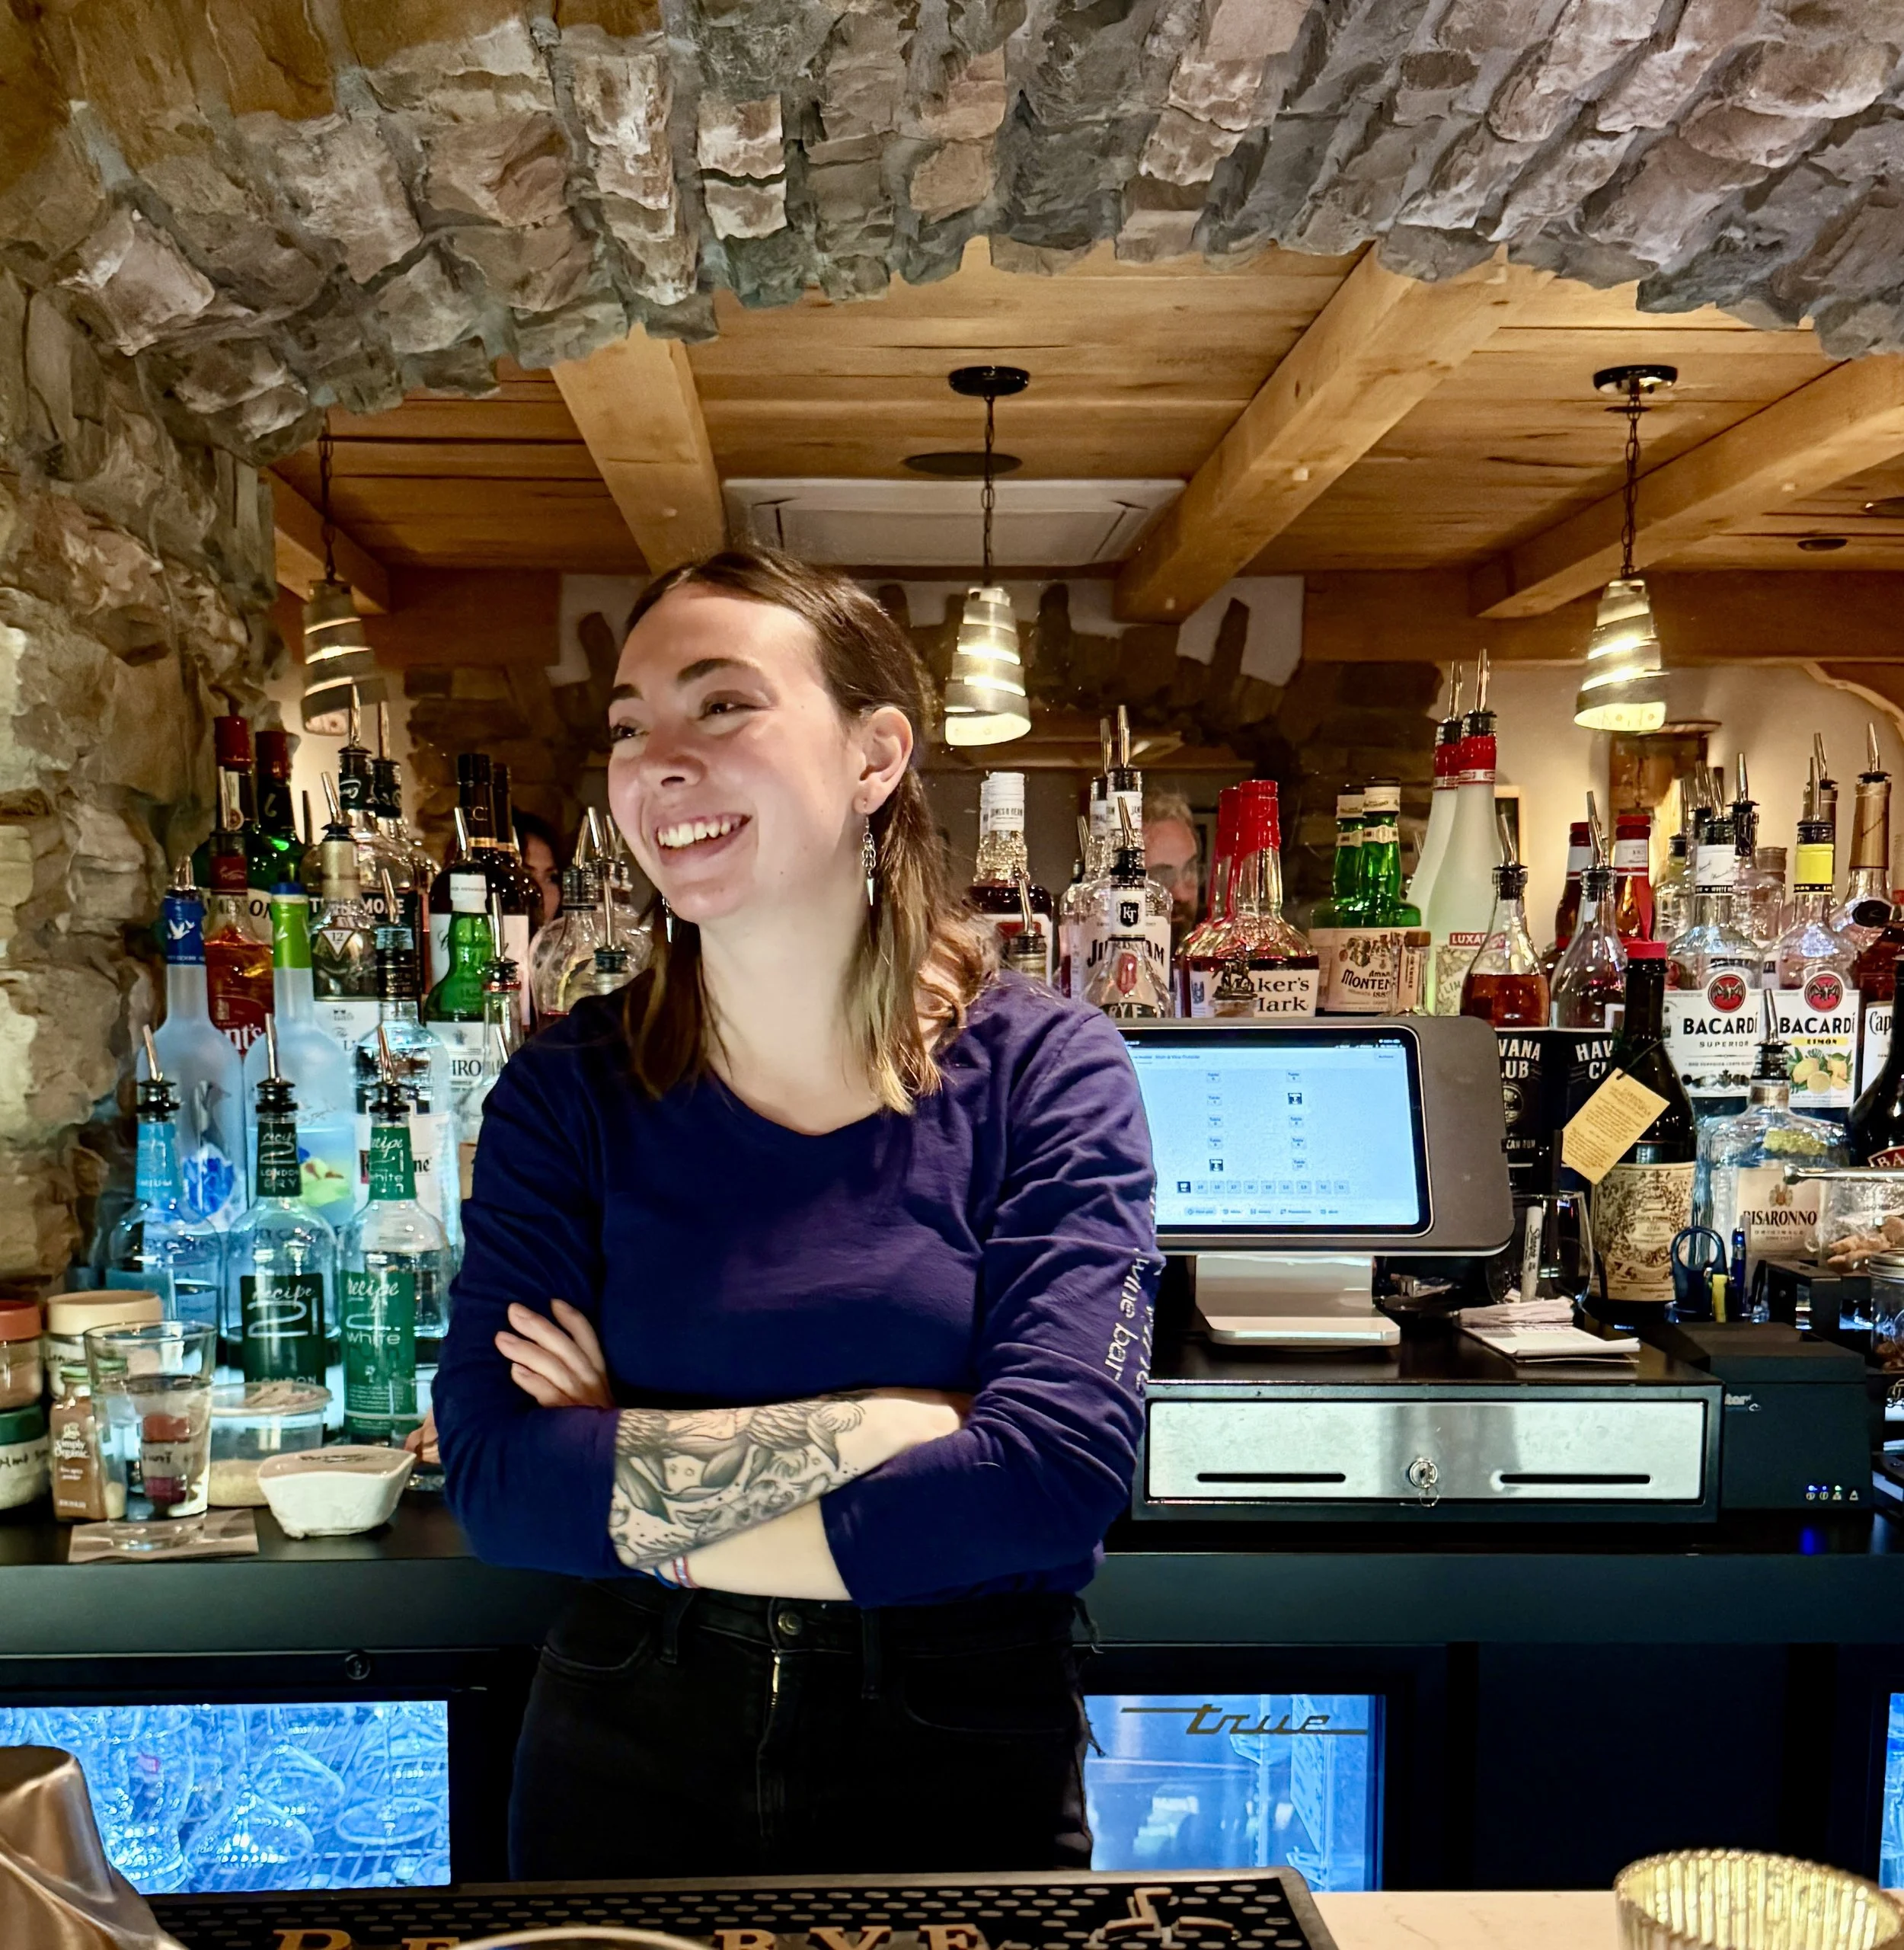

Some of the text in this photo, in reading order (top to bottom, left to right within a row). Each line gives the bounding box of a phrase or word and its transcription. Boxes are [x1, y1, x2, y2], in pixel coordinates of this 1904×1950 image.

[331, 932, 343, 942] 12
[1243, 977, 1310, 993] ker's
[1501, 1060, 1529, 1079] UB
[347, 1331, 401, 1345] white
[1105, 1322, 1139, 1382] bar
[1122, 1704, 1368, 1734] true
